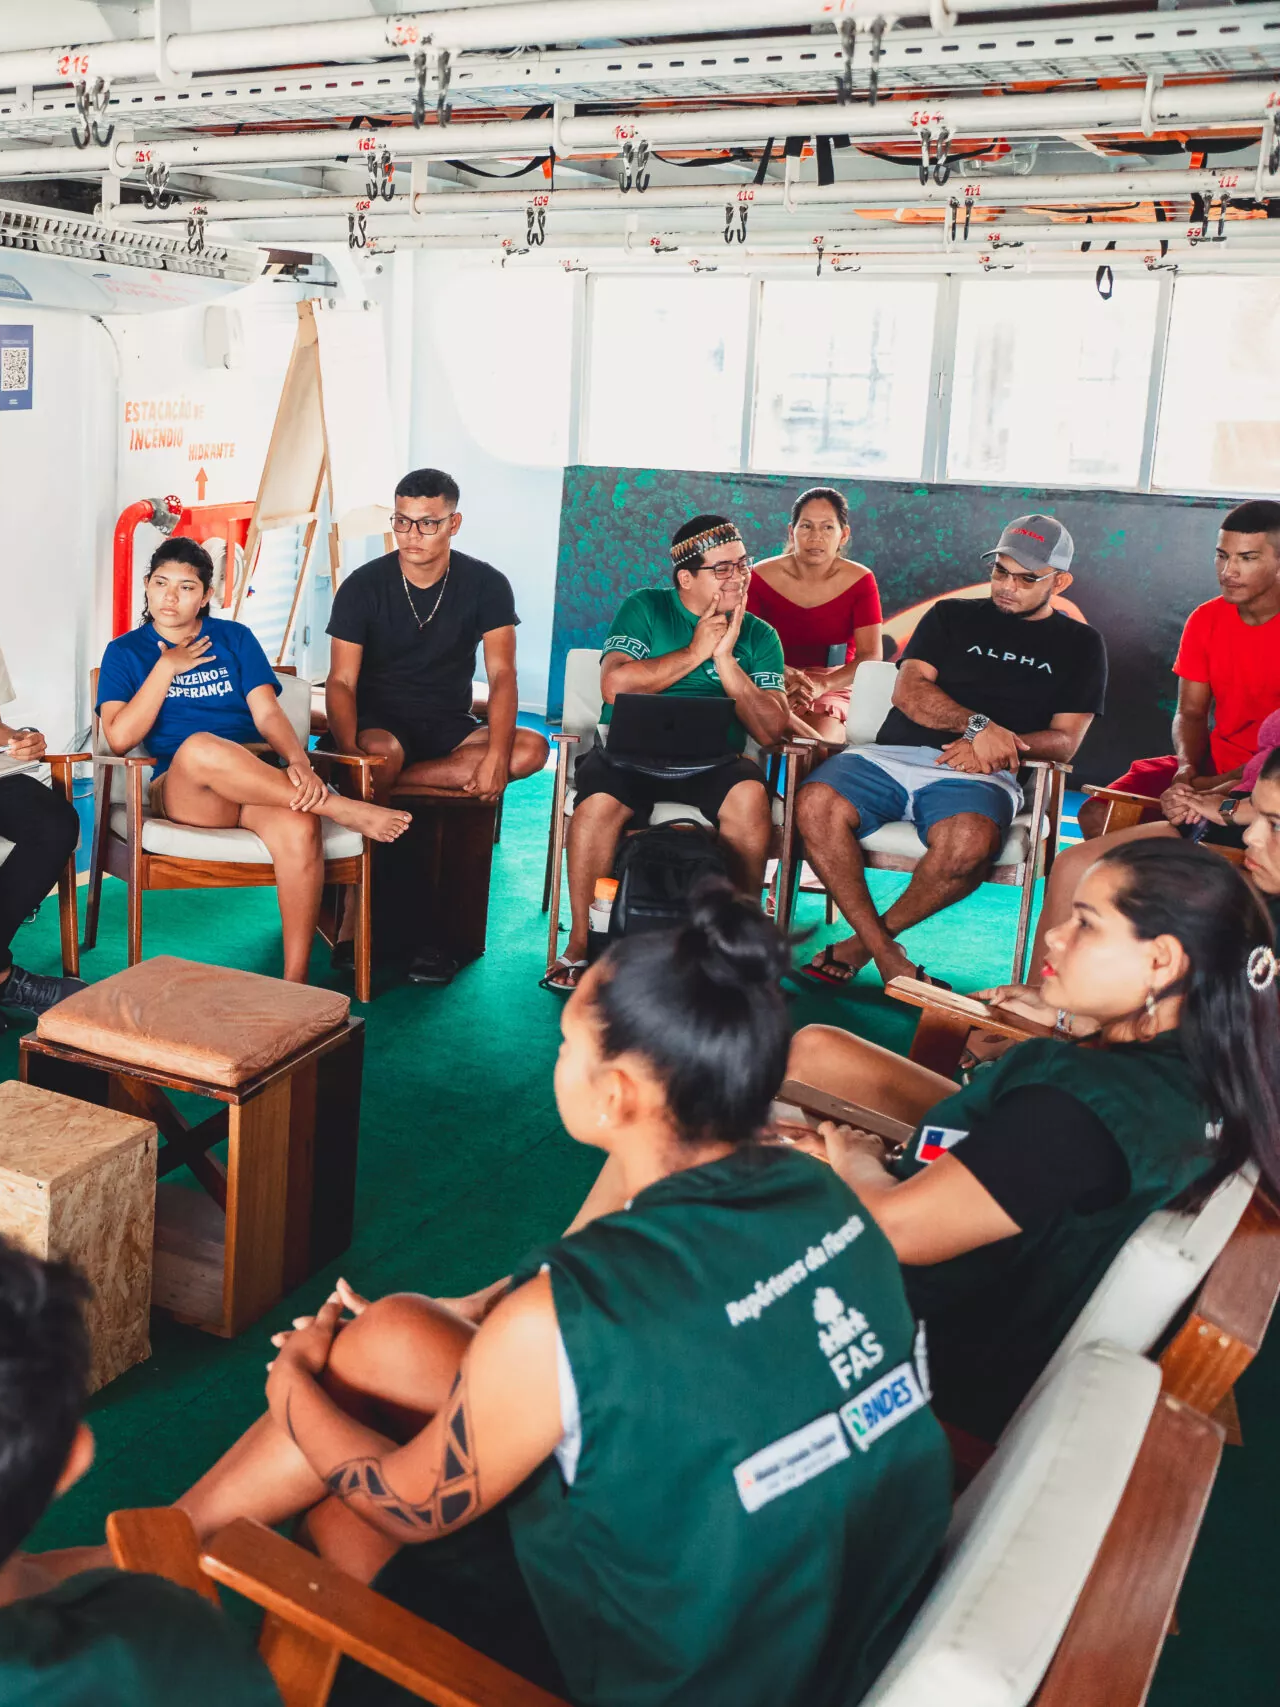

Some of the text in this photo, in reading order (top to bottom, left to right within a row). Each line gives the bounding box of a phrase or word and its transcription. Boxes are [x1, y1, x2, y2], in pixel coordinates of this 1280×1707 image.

[58, 55, 88, 75] 215
[736, 190, 754, 201] 110
[1186, 227, 1201, 237] 59
[188, 442, 236, 461] HIDRANTE
[967, 645, 1053, 674] ALPHA
[170, 669, 219, 686] ANZEIRO
[829, 1332, 884, 1390] FAS
[861, 1375, 913, 1430] BNDES
